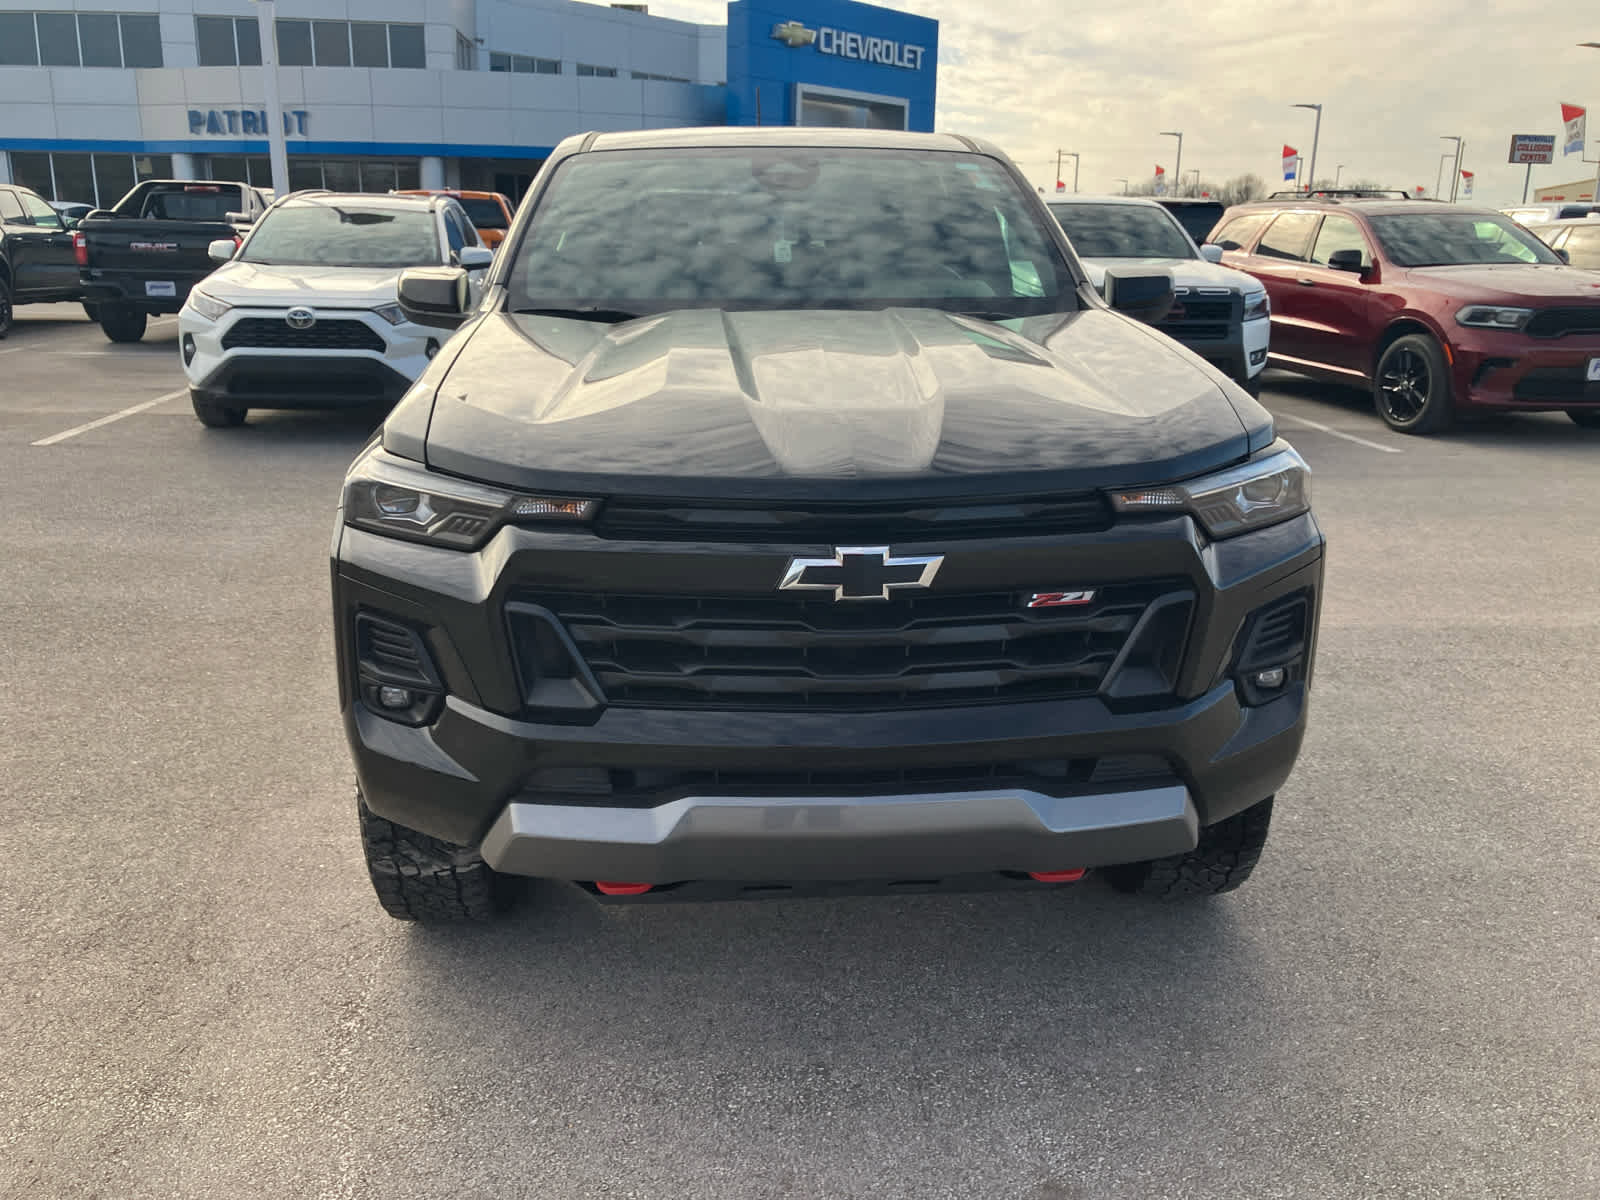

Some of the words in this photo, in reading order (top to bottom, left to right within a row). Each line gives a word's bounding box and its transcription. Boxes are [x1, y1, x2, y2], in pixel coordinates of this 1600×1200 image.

[820, 27, 925, 70] CHEVROLET
[187, 110, 308, 136] PATRIT
[1027, 591, 1095, 608] Z71
